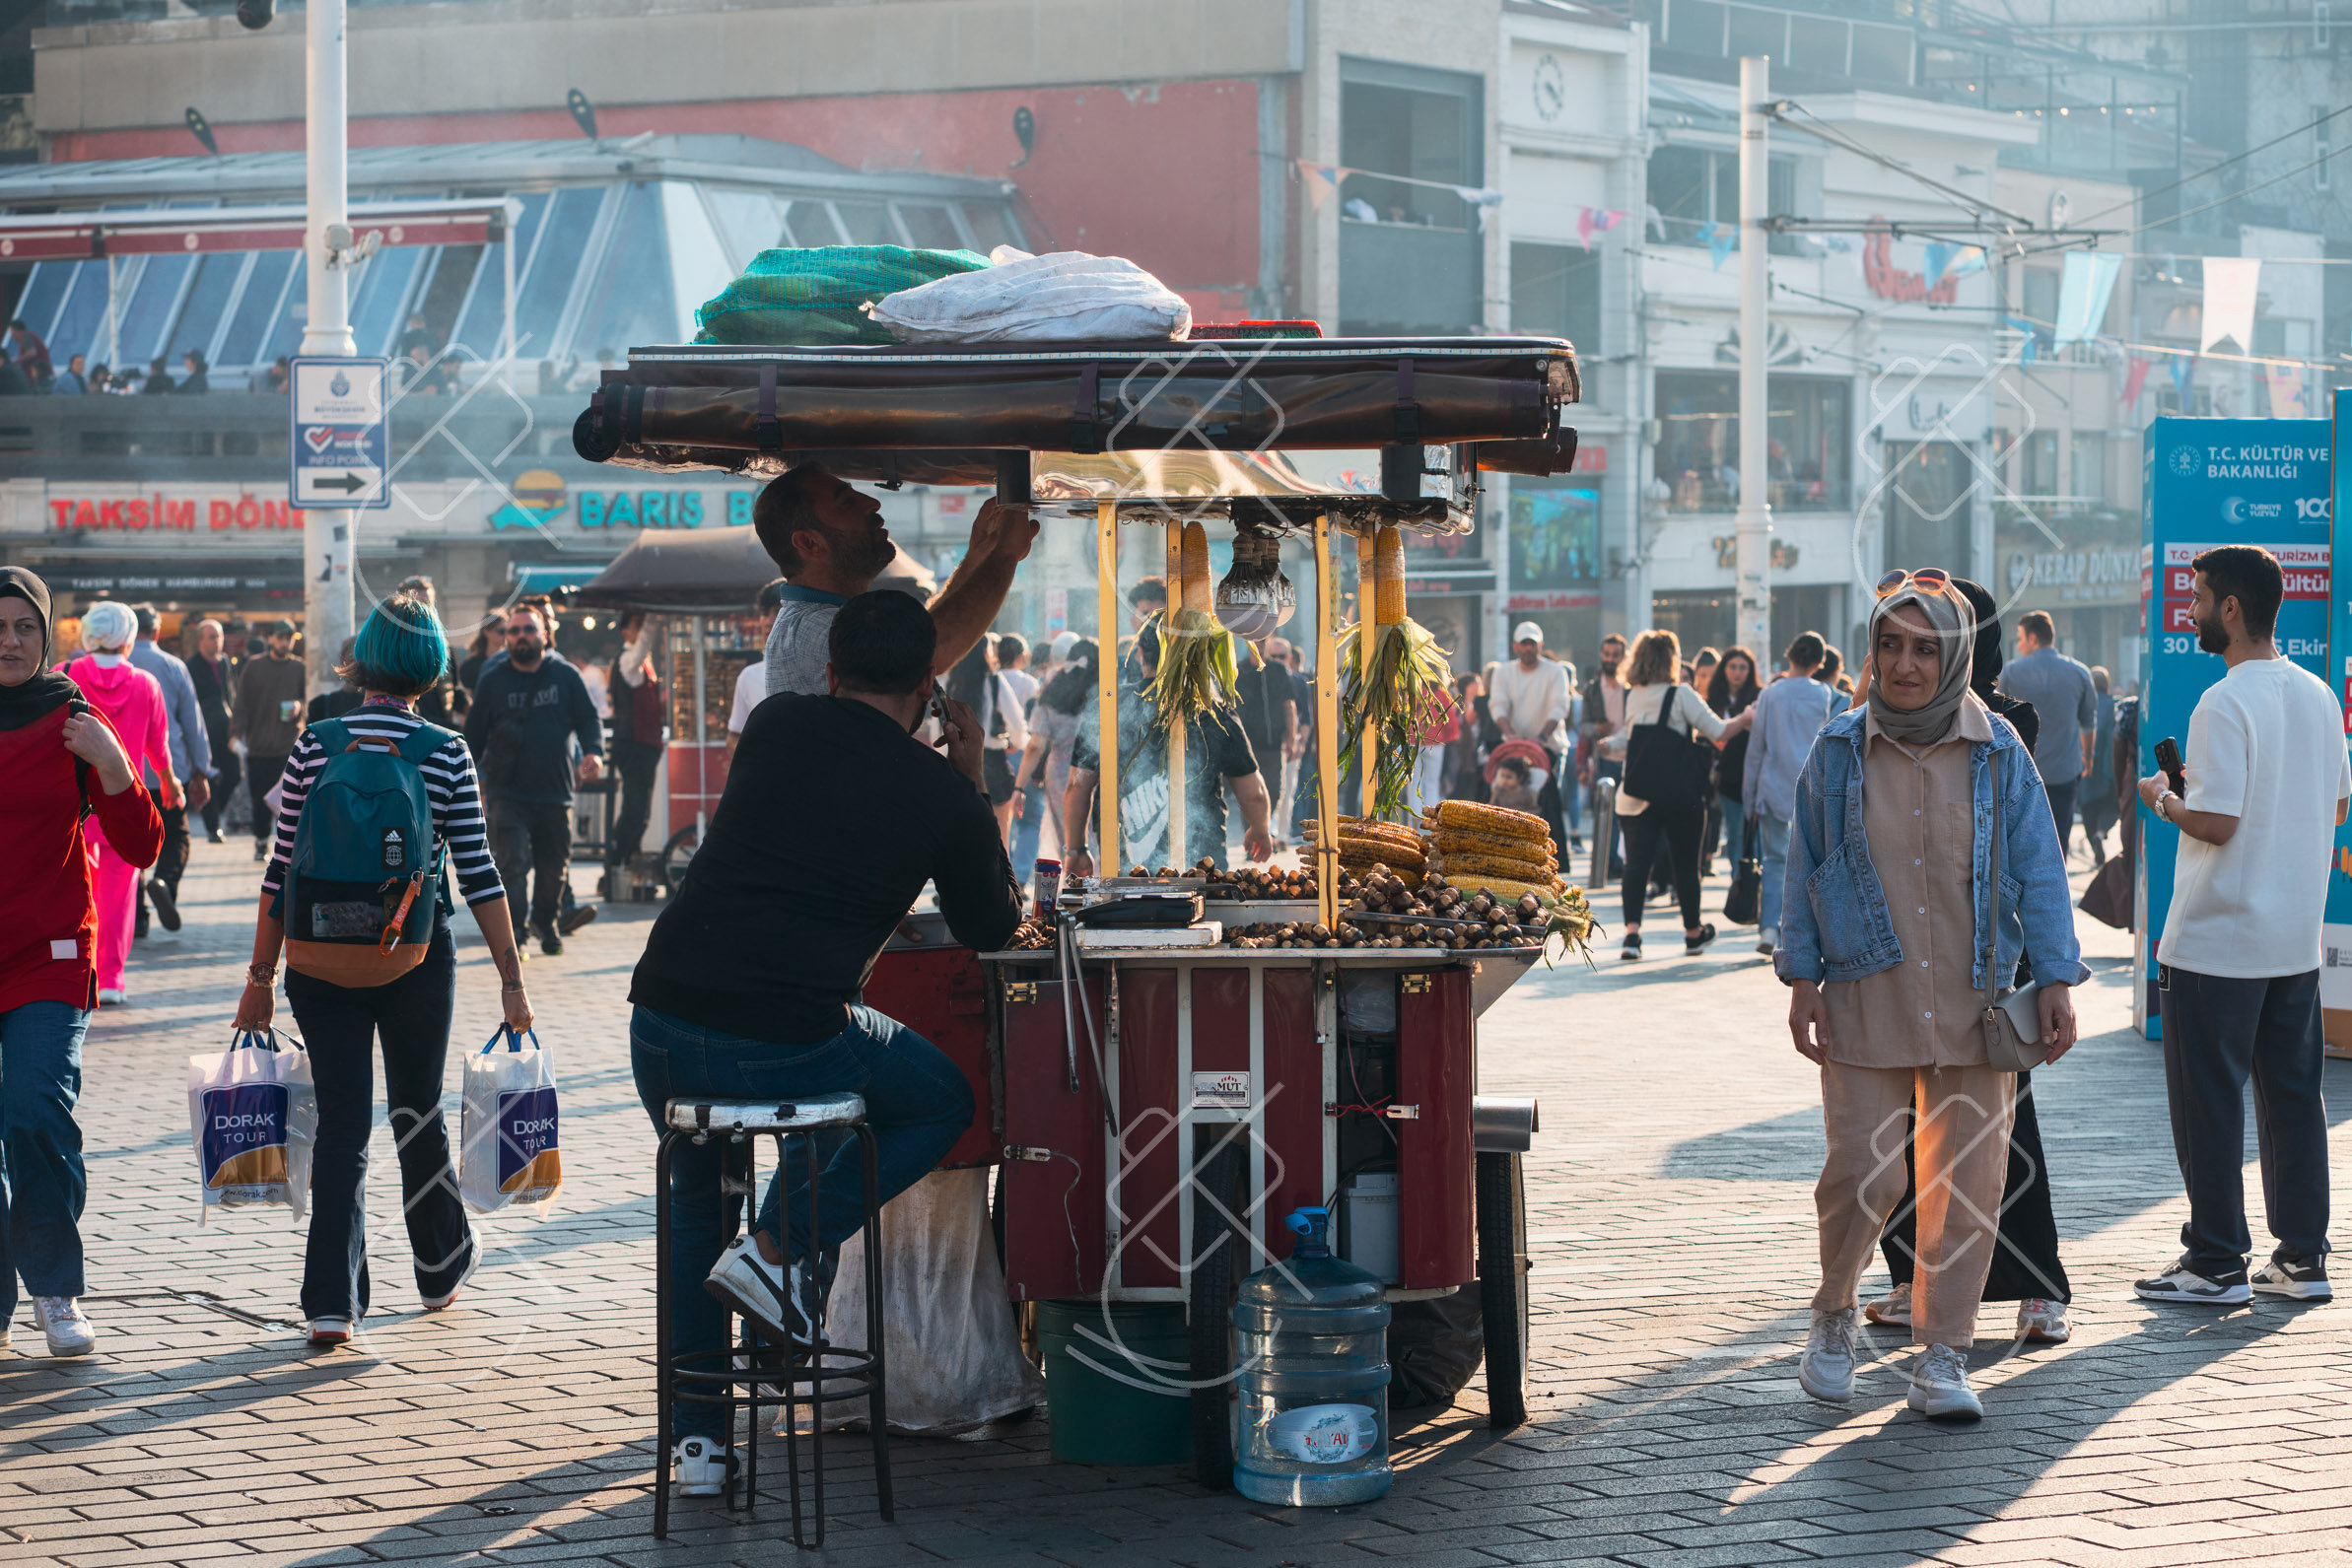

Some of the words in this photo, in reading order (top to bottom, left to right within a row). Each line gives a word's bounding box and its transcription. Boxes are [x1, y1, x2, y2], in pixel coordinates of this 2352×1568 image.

[309, 455, 335, 466] INFO
[2207, 446, 2236, 461] T.C.
[2240, 444, 2304, 461] KÜLTÜR
[2308, 447, 2328, 461] VE
[2207, 463, 2298, 479] BAKANLIĞI
[49, 492, 196, 530] TAKSİM
[2033, 552, 2086, 586] KEBAP
[2283, 573, 2330, 592] ültü
[2163, 637, 2189, 654] 30
[215, 1113, 275, 1130] DORAK
[513, 1117, 555, 1135] DORAK
[223, 1131, 267, 1144] TOUR
[522, 1135, 547, 1150] TOUR
